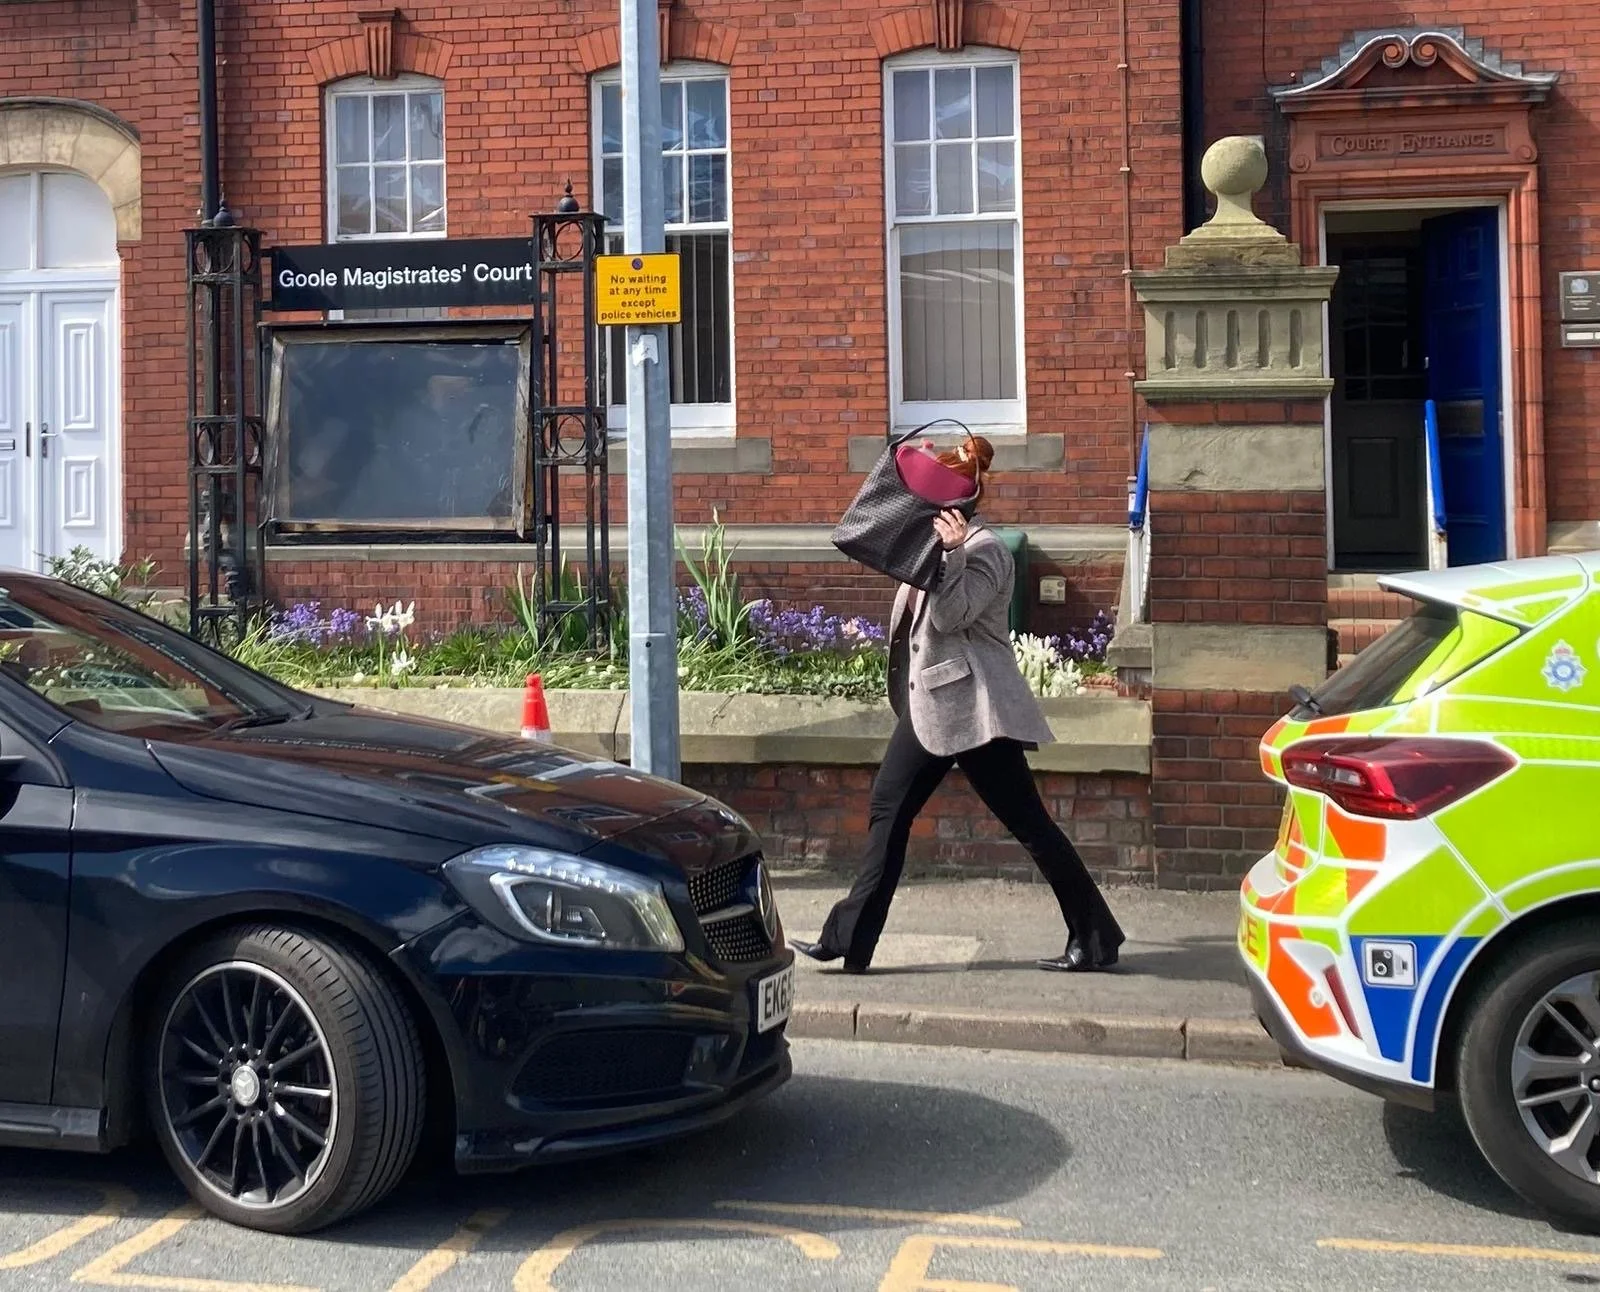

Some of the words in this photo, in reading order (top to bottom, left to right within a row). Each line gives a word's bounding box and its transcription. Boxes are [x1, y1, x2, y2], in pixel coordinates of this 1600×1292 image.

[1331, 135, 1391, 155] COURT
[1400, 132, 1495, 153] ENTRANCE
[279, 268, 337, 288] Goole
[343, 263, 467, 289] Magistrates'
[473, 262, 532, 282] Court
[610, 275, 625, 284] No
[628, 274, 667, 284] waiting
[609, 286, 620, 296] at
[623, 286, 641, 296] any
[644, 286, 667, 294] time
[621, 298, 656, 308] except
[601, 310, 632, 320] police
[635, 309, 677, 318] vehicles
